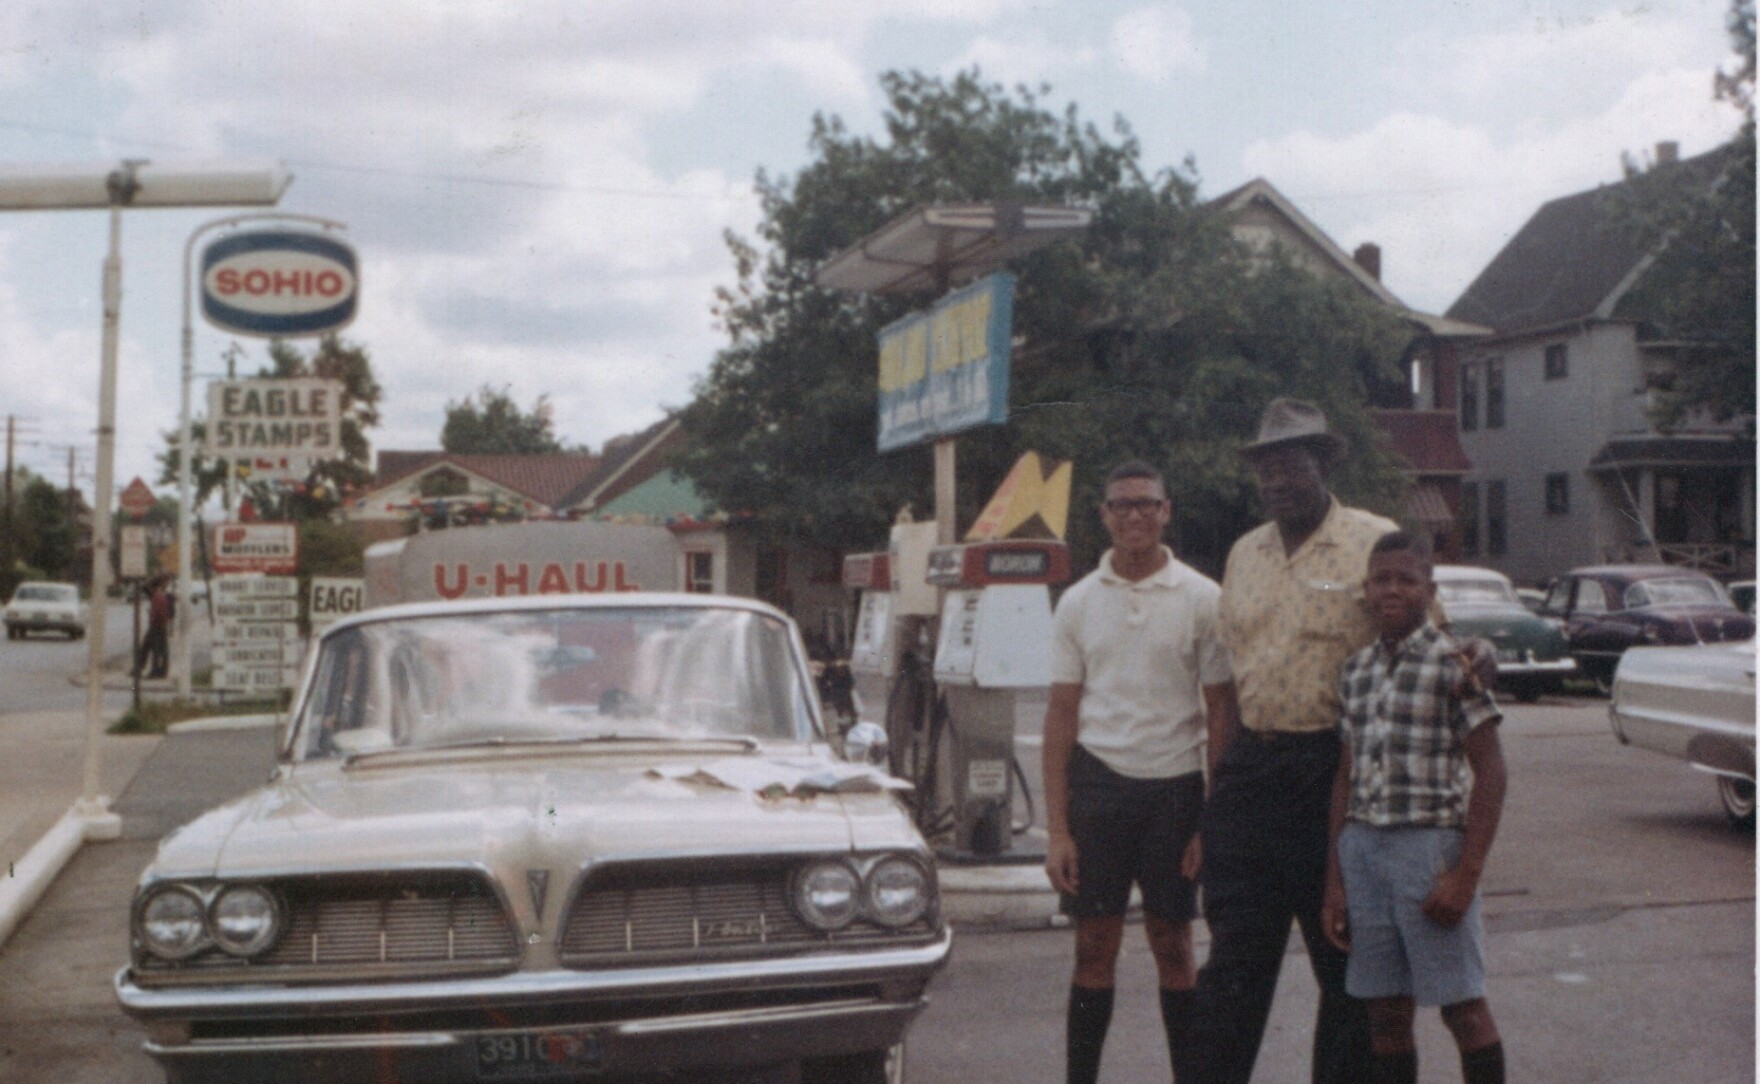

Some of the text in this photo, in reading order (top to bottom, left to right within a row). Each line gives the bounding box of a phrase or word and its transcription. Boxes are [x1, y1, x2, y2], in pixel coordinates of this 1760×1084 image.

[215, 268, 344, 297] SOHIO
[222, 387, 329, 417] EAGLE
[216, 421, 331, 448] STAMPS
